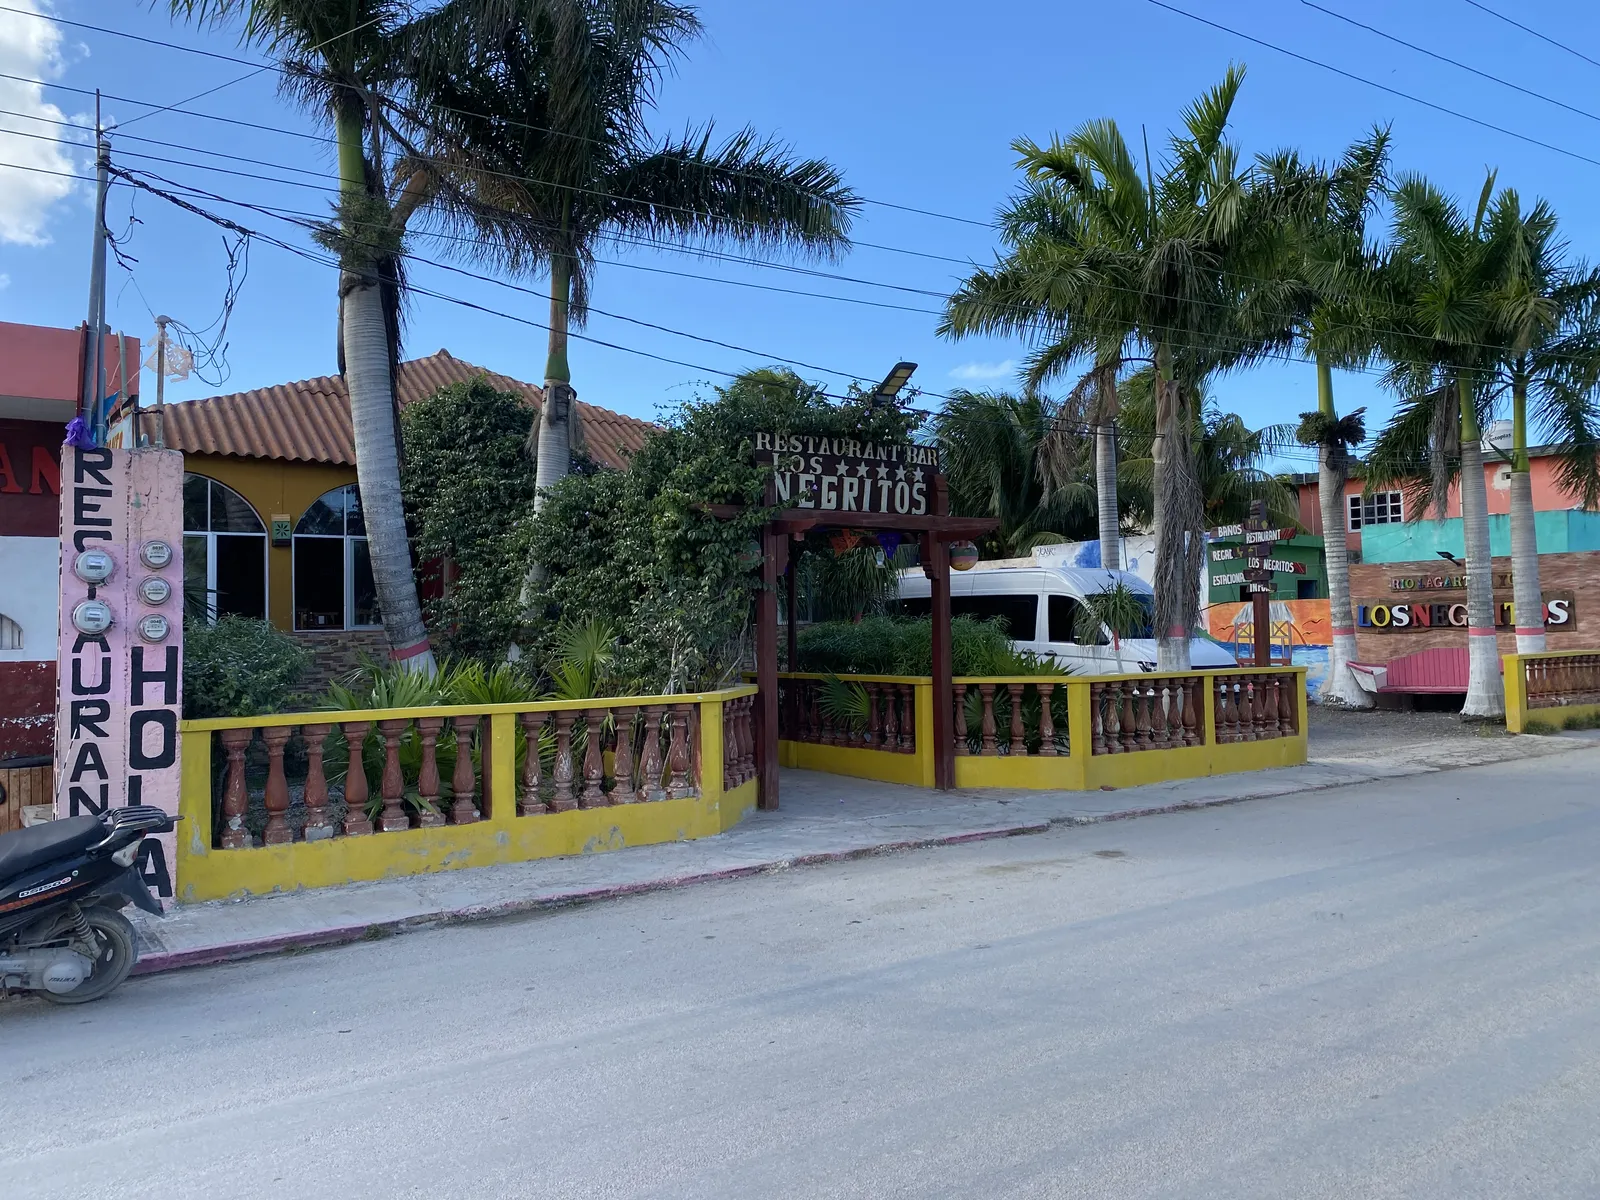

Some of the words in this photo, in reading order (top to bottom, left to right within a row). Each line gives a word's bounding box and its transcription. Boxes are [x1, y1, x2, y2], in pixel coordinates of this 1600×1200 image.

[755, 432, 901, 462] RESTAURANT
[903, 446, 938, 467] BAR
[772, 452, 823, 475] LOS
[774, 471, 927, 515] NEGRITOS
[1246, 529, 1281, 544] RESTAURANT
[1248, 557, 1260, 568] LOS
[1263, 559, 1295, 573] NEGRITOS
[1418, 575, 1471, 590] LAGART
[1412, 600, 1569, 628] NEGITS
